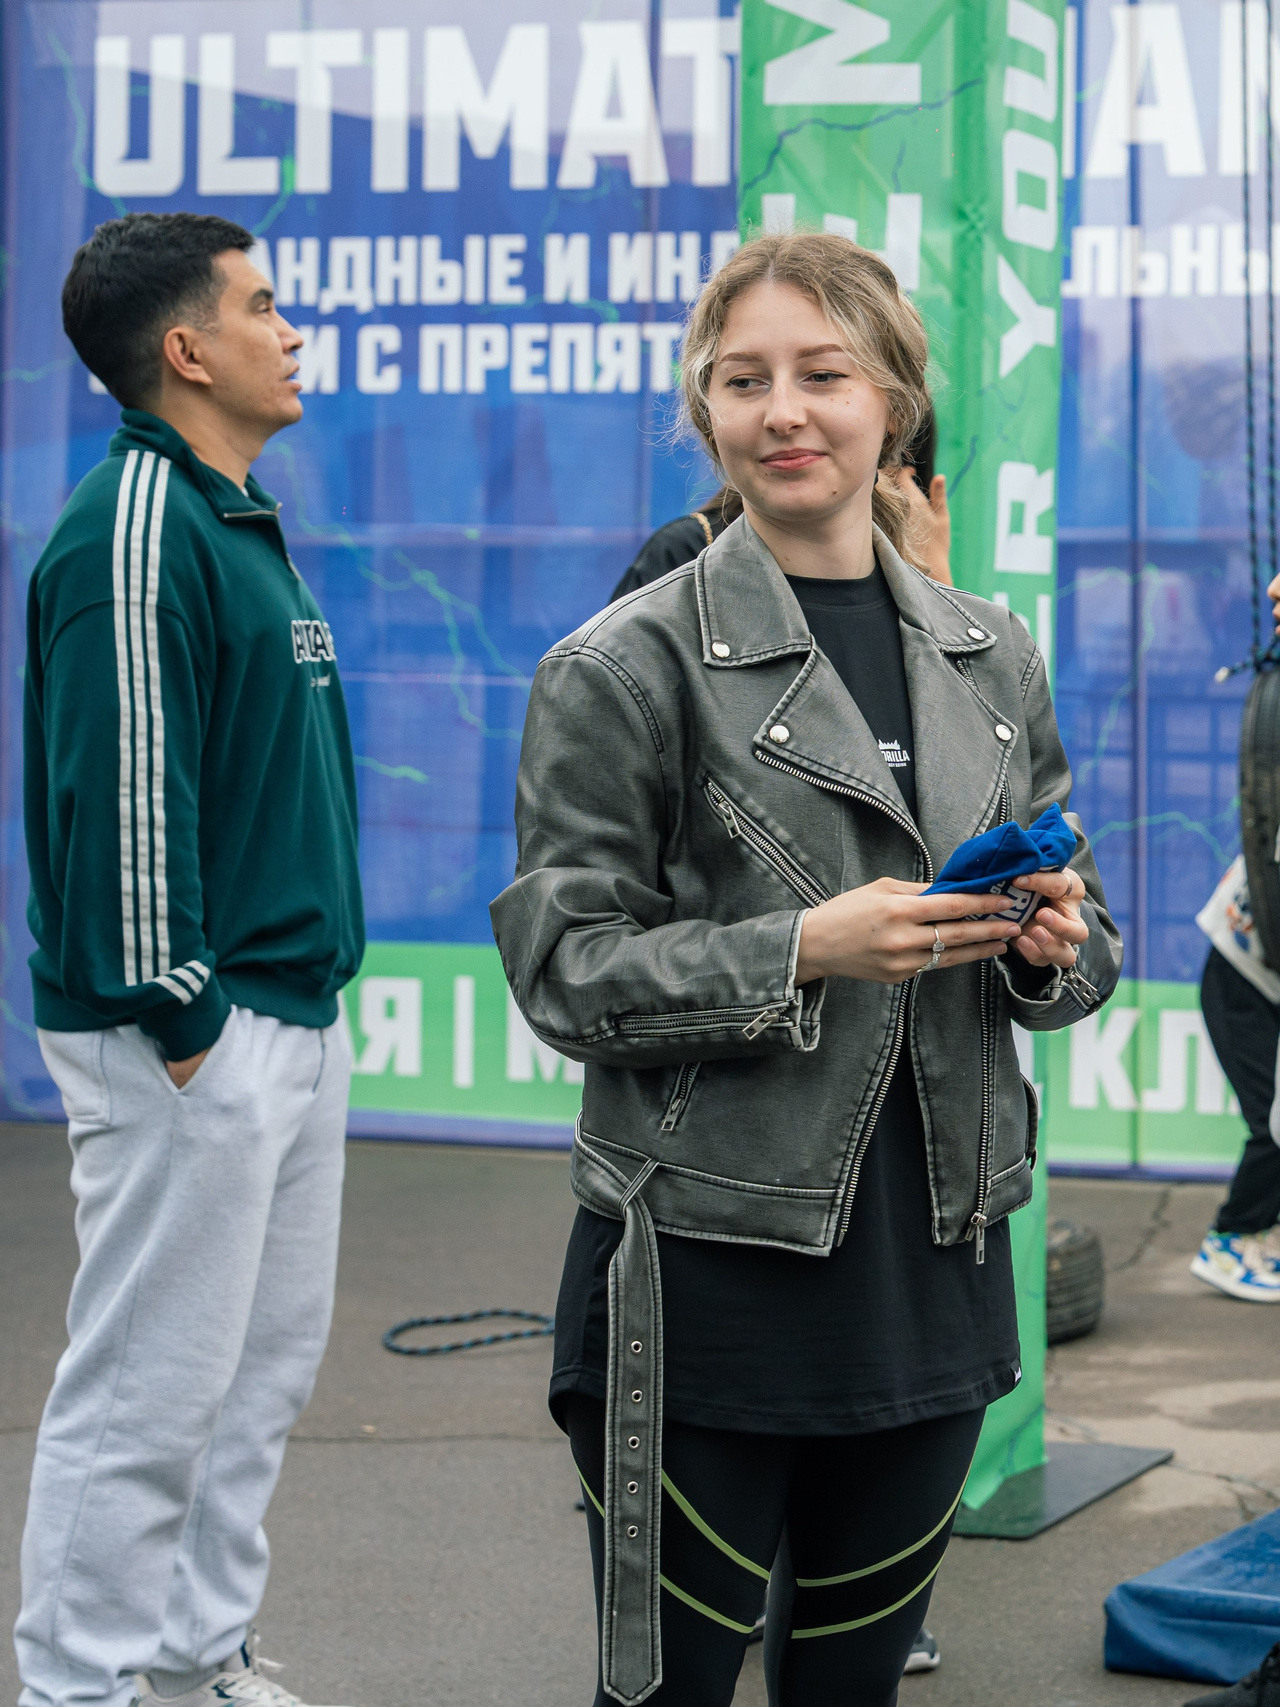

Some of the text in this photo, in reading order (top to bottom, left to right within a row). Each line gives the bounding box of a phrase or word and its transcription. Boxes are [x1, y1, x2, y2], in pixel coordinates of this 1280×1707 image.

[94, 18, 740, 198] ULTIMAT
[543, 232, 591, 304] И
[355, 322, 403, 395] С
[418, 321, 684, 395] ПРЕПЯТ
